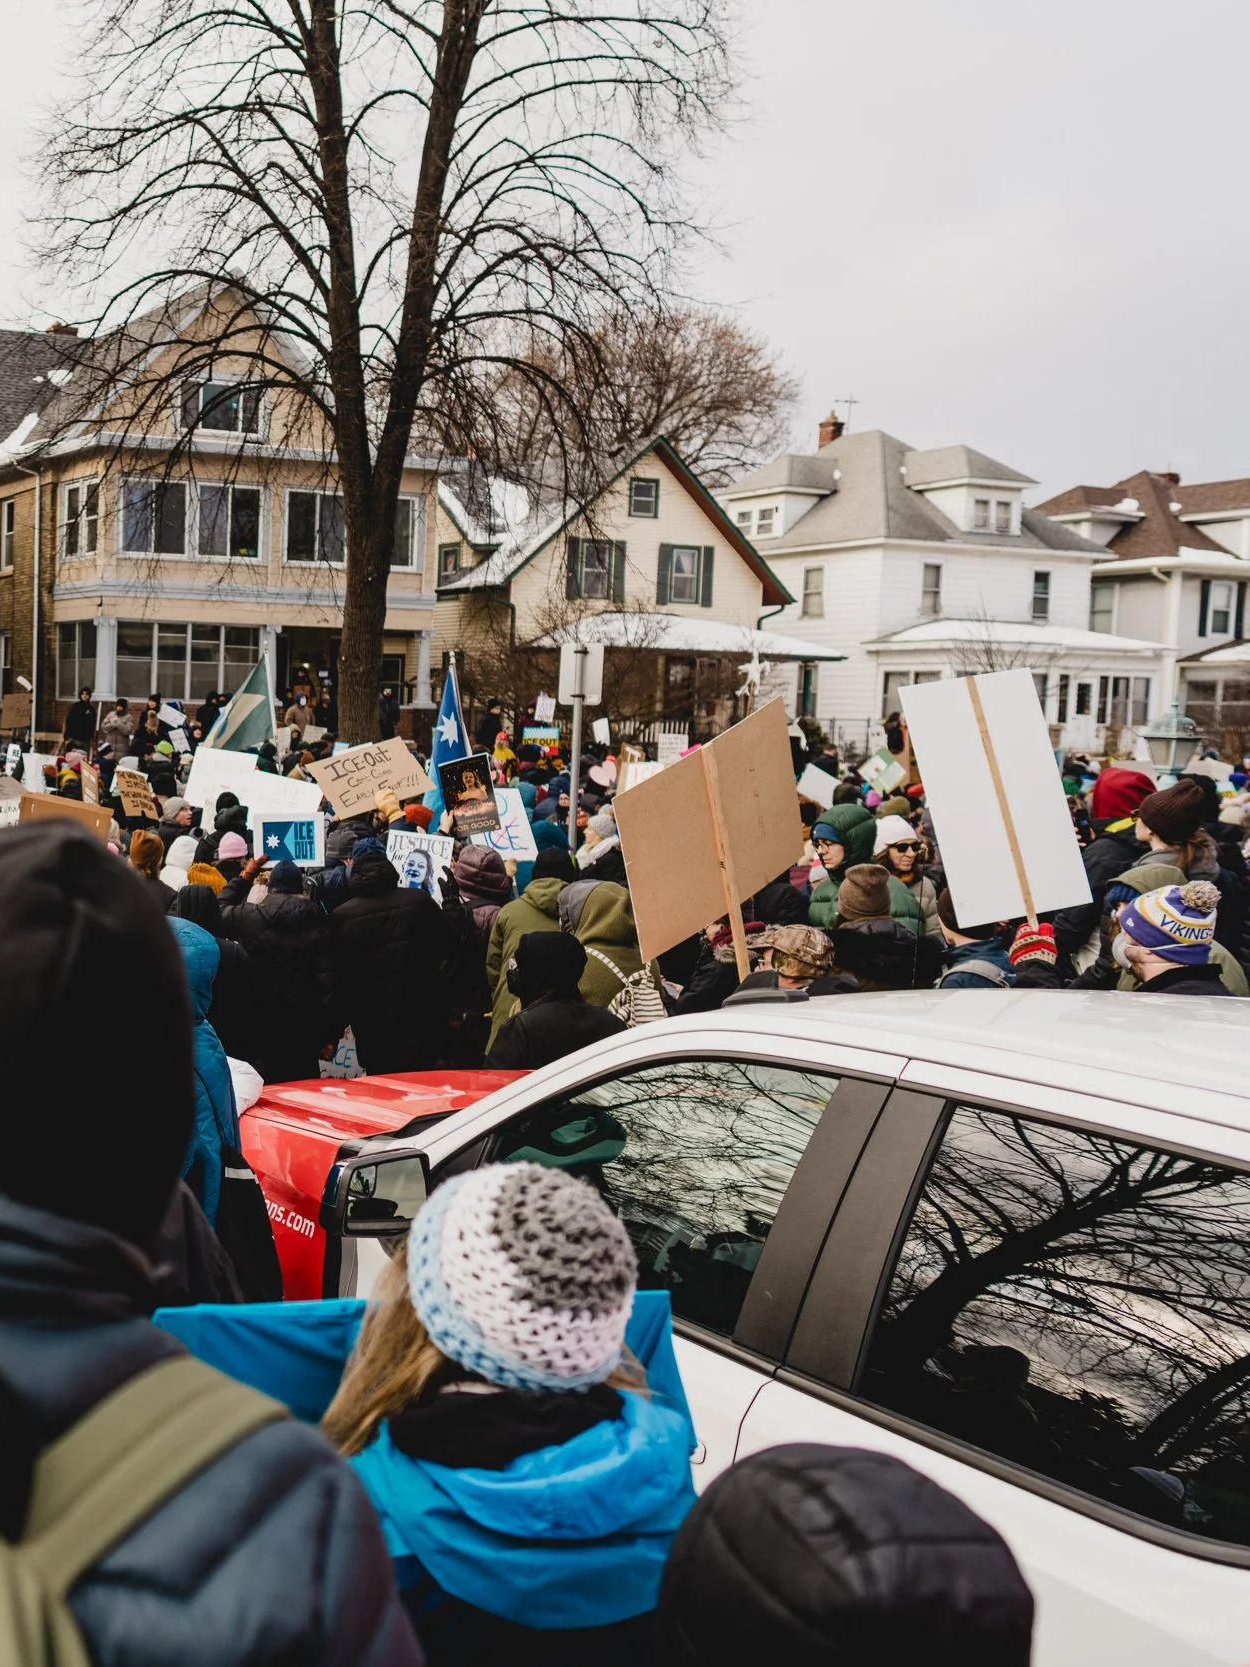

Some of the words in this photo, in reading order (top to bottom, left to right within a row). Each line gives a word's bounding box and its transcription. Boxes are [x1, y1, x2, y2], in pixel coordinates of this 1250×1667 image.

[540, 738, 558, 747] OUT
[294, 822, 314, 840] ICE
[470, 820, 496, 830] GOOD
[295, 842, 315, 860] OUT
[389, 833, 451, 860] JUSTICE
[391, 850, 407, 862] for
[331, 1045, 356, 1068] CE
